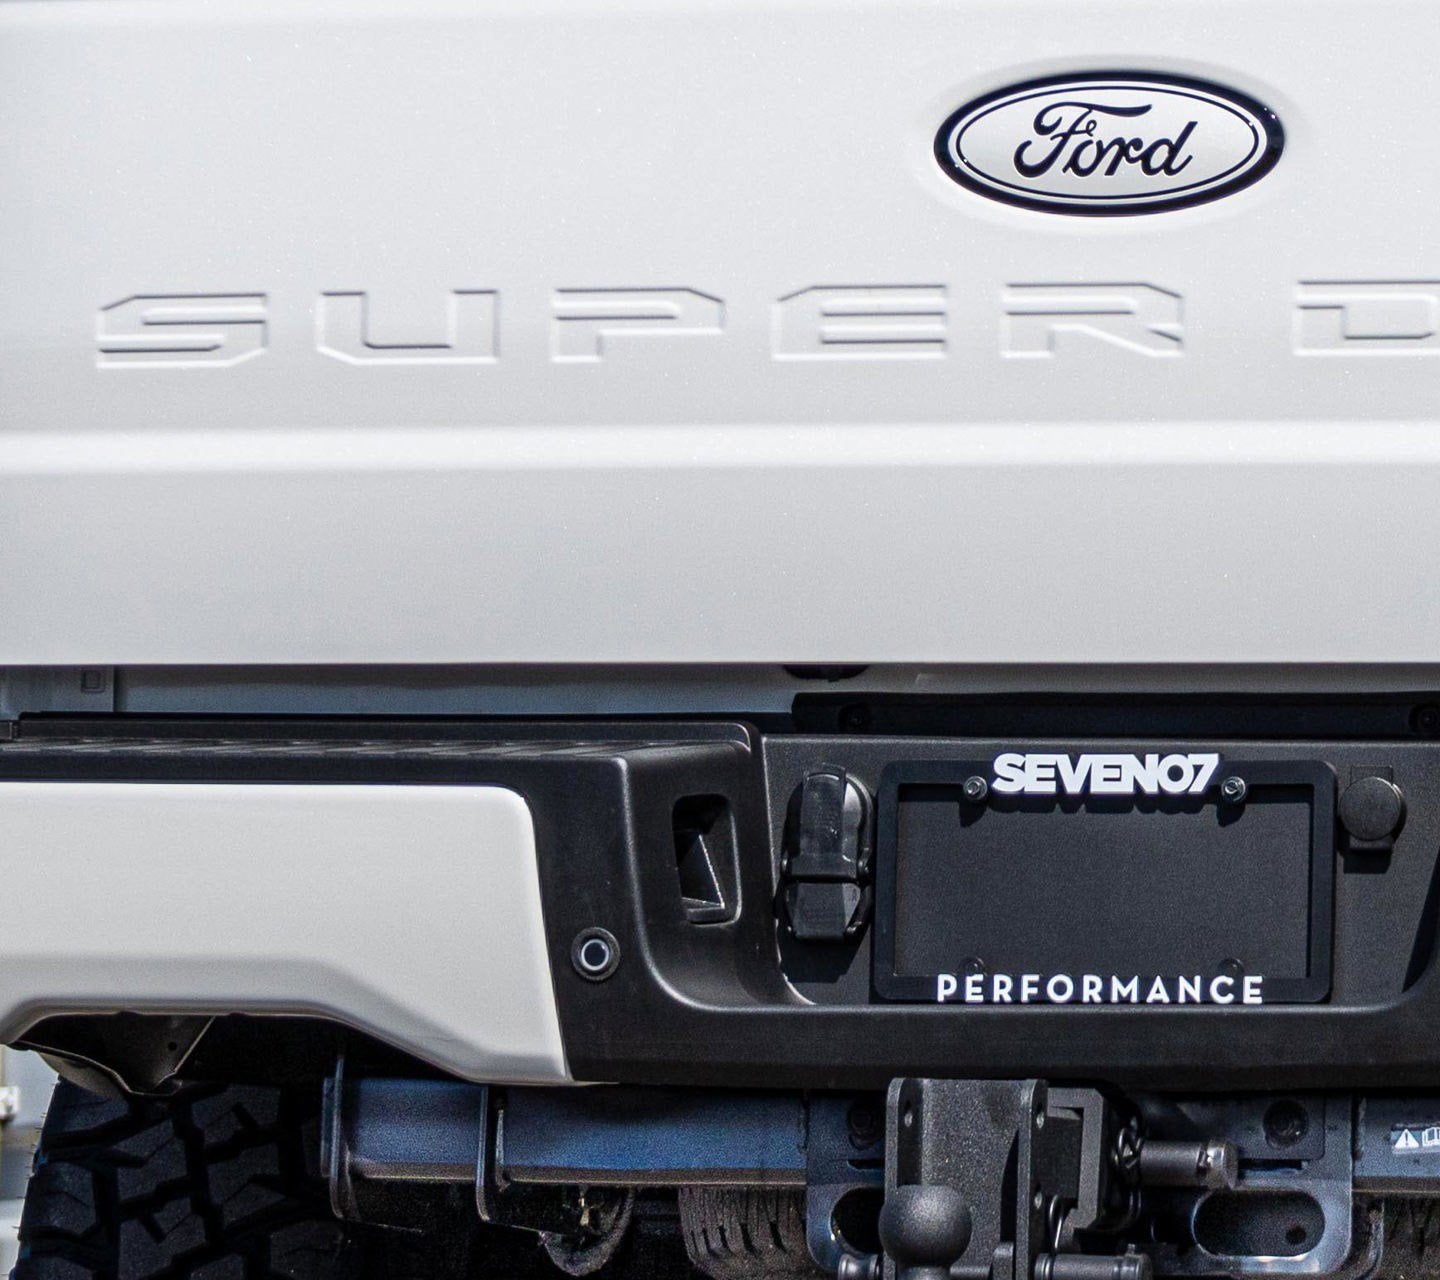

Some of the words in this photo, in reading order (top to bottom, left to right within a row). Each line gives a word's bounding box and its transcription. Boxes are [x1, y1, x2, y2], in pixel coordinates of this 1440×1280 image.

[1013, 101, 1193, 177] Ford
[94, 282, 1186, 368] SUPER
[937, 974, 1263, 1005] PERFORMANCE
